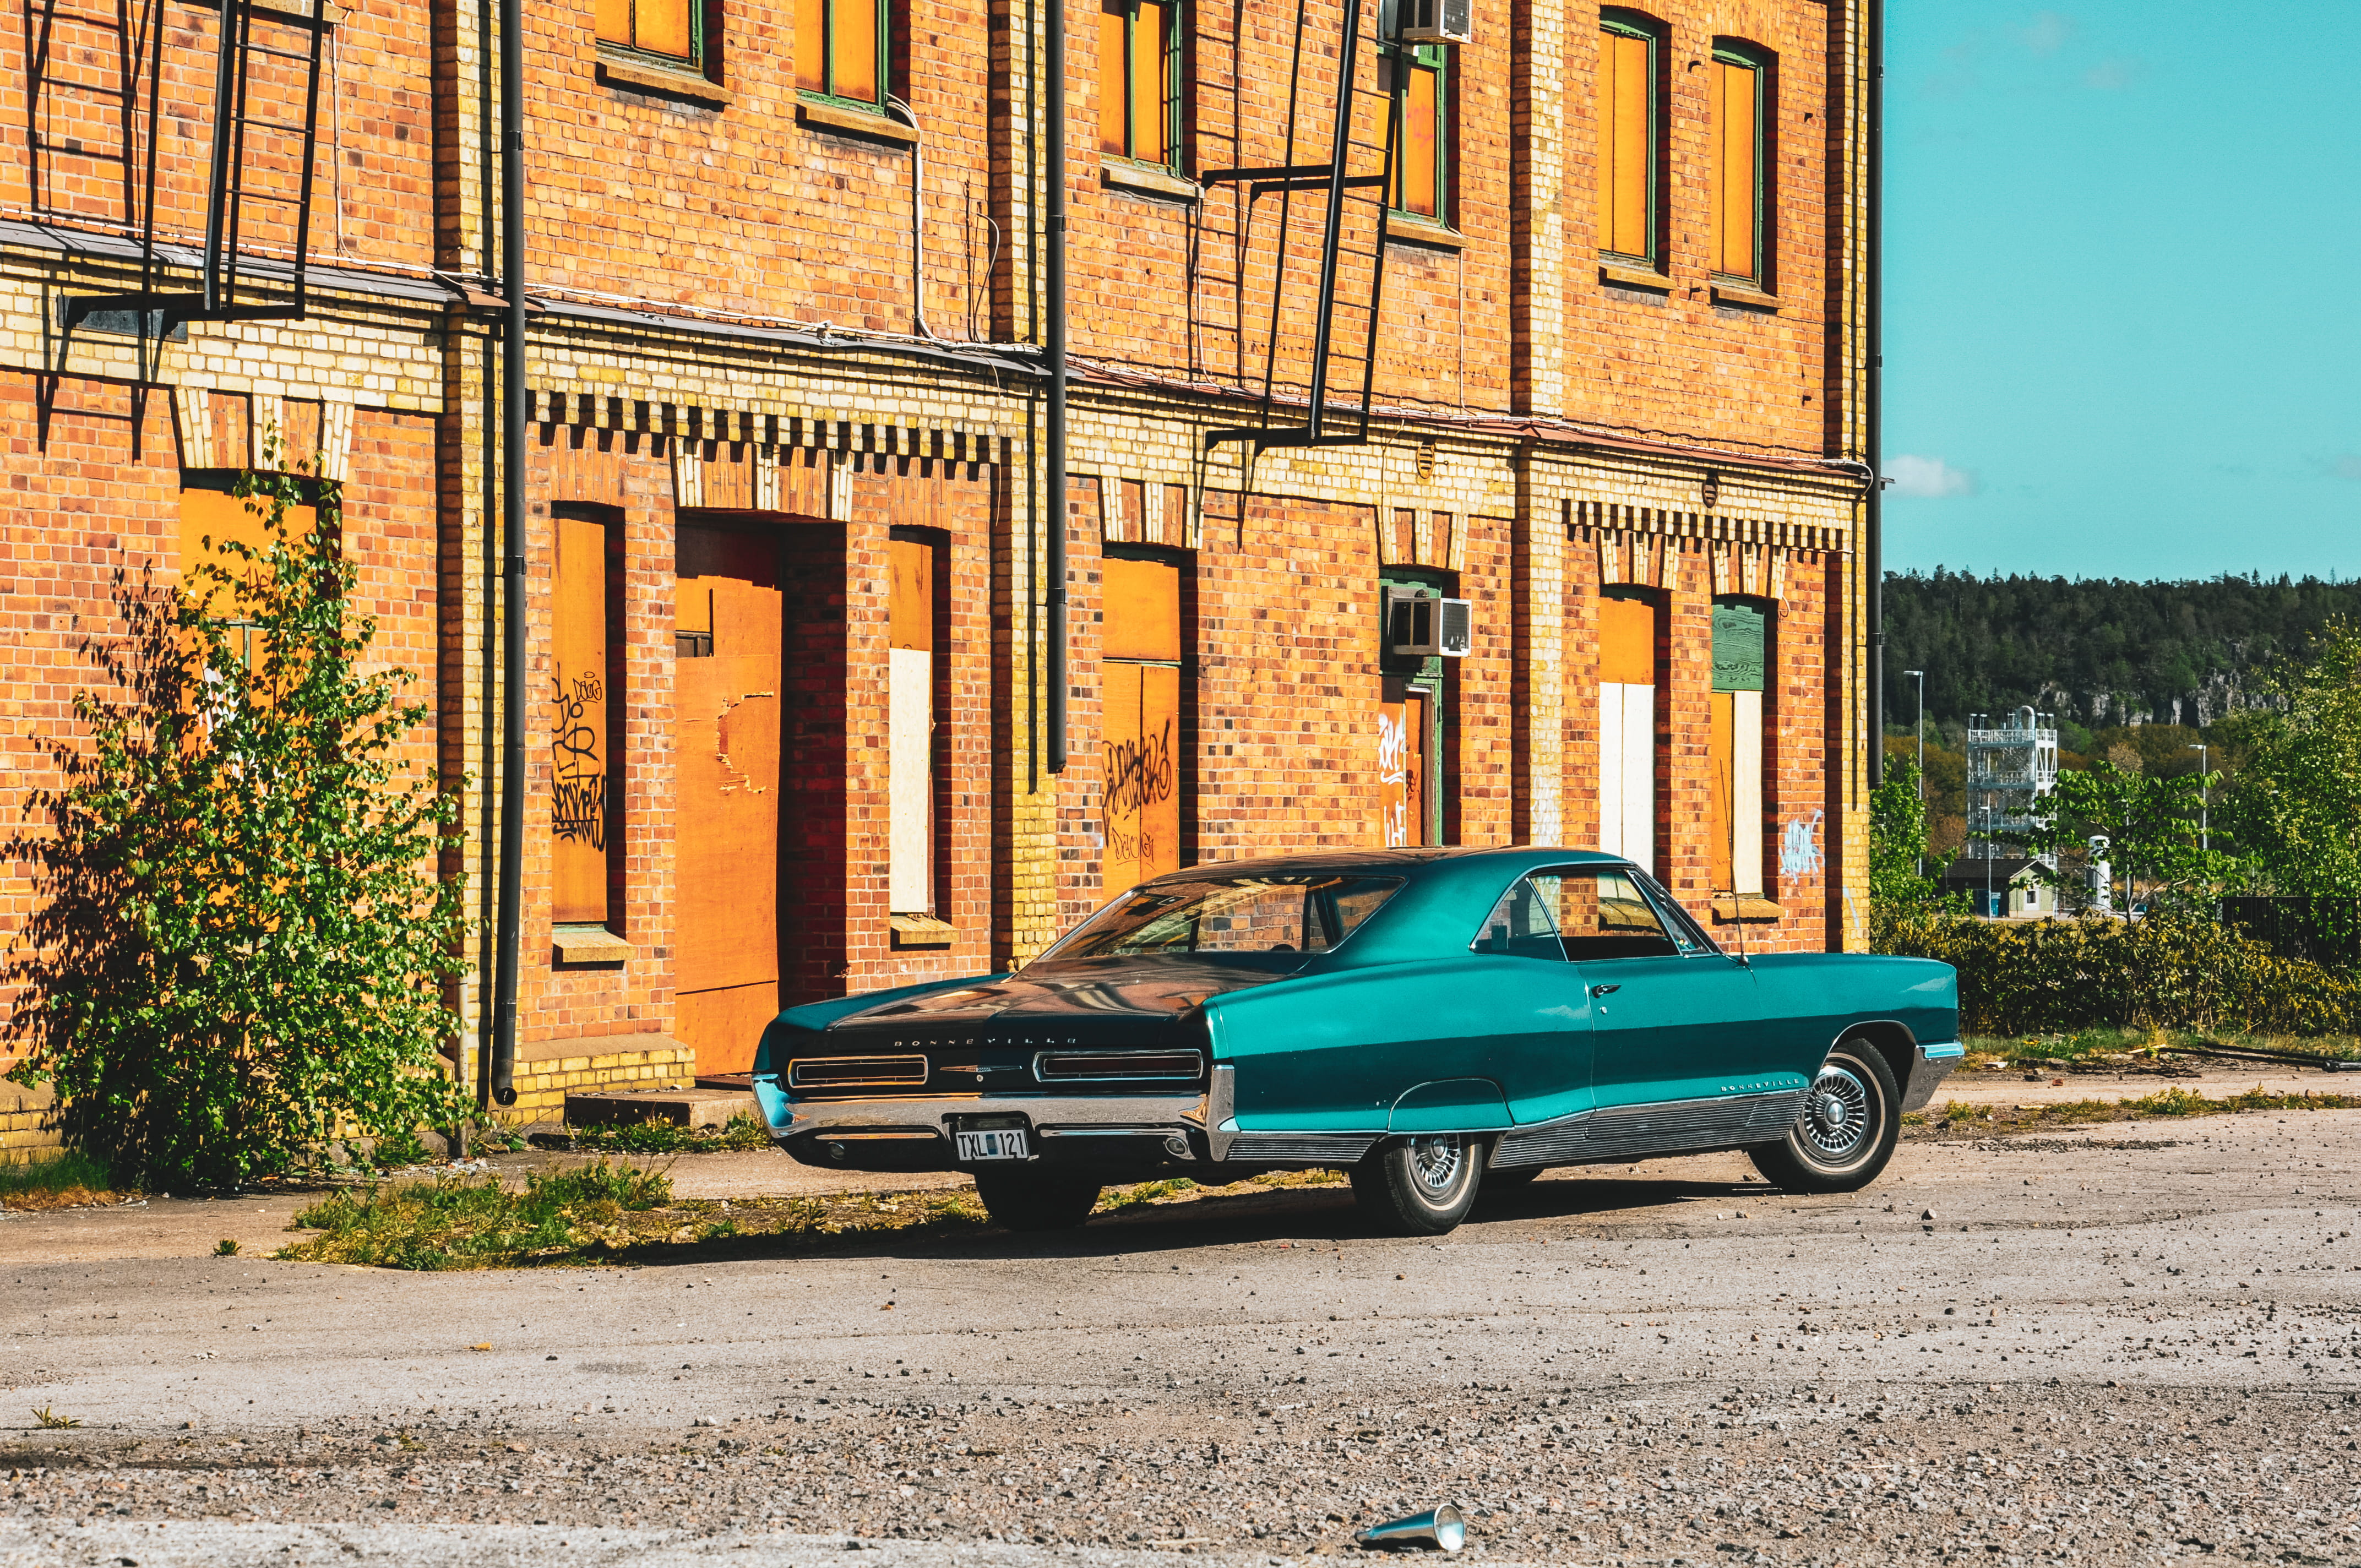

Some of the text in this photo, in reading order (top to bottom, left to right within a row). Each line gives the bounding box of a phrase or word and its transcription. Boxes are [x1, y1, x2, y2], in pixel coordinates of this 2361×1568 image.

[895, 1038, 1076, 1047] BONNEVILLE
[1721, 1079, 1799, 1092] BONNEVILLE
[958, 1133, 1024, 1157] TXL 121
